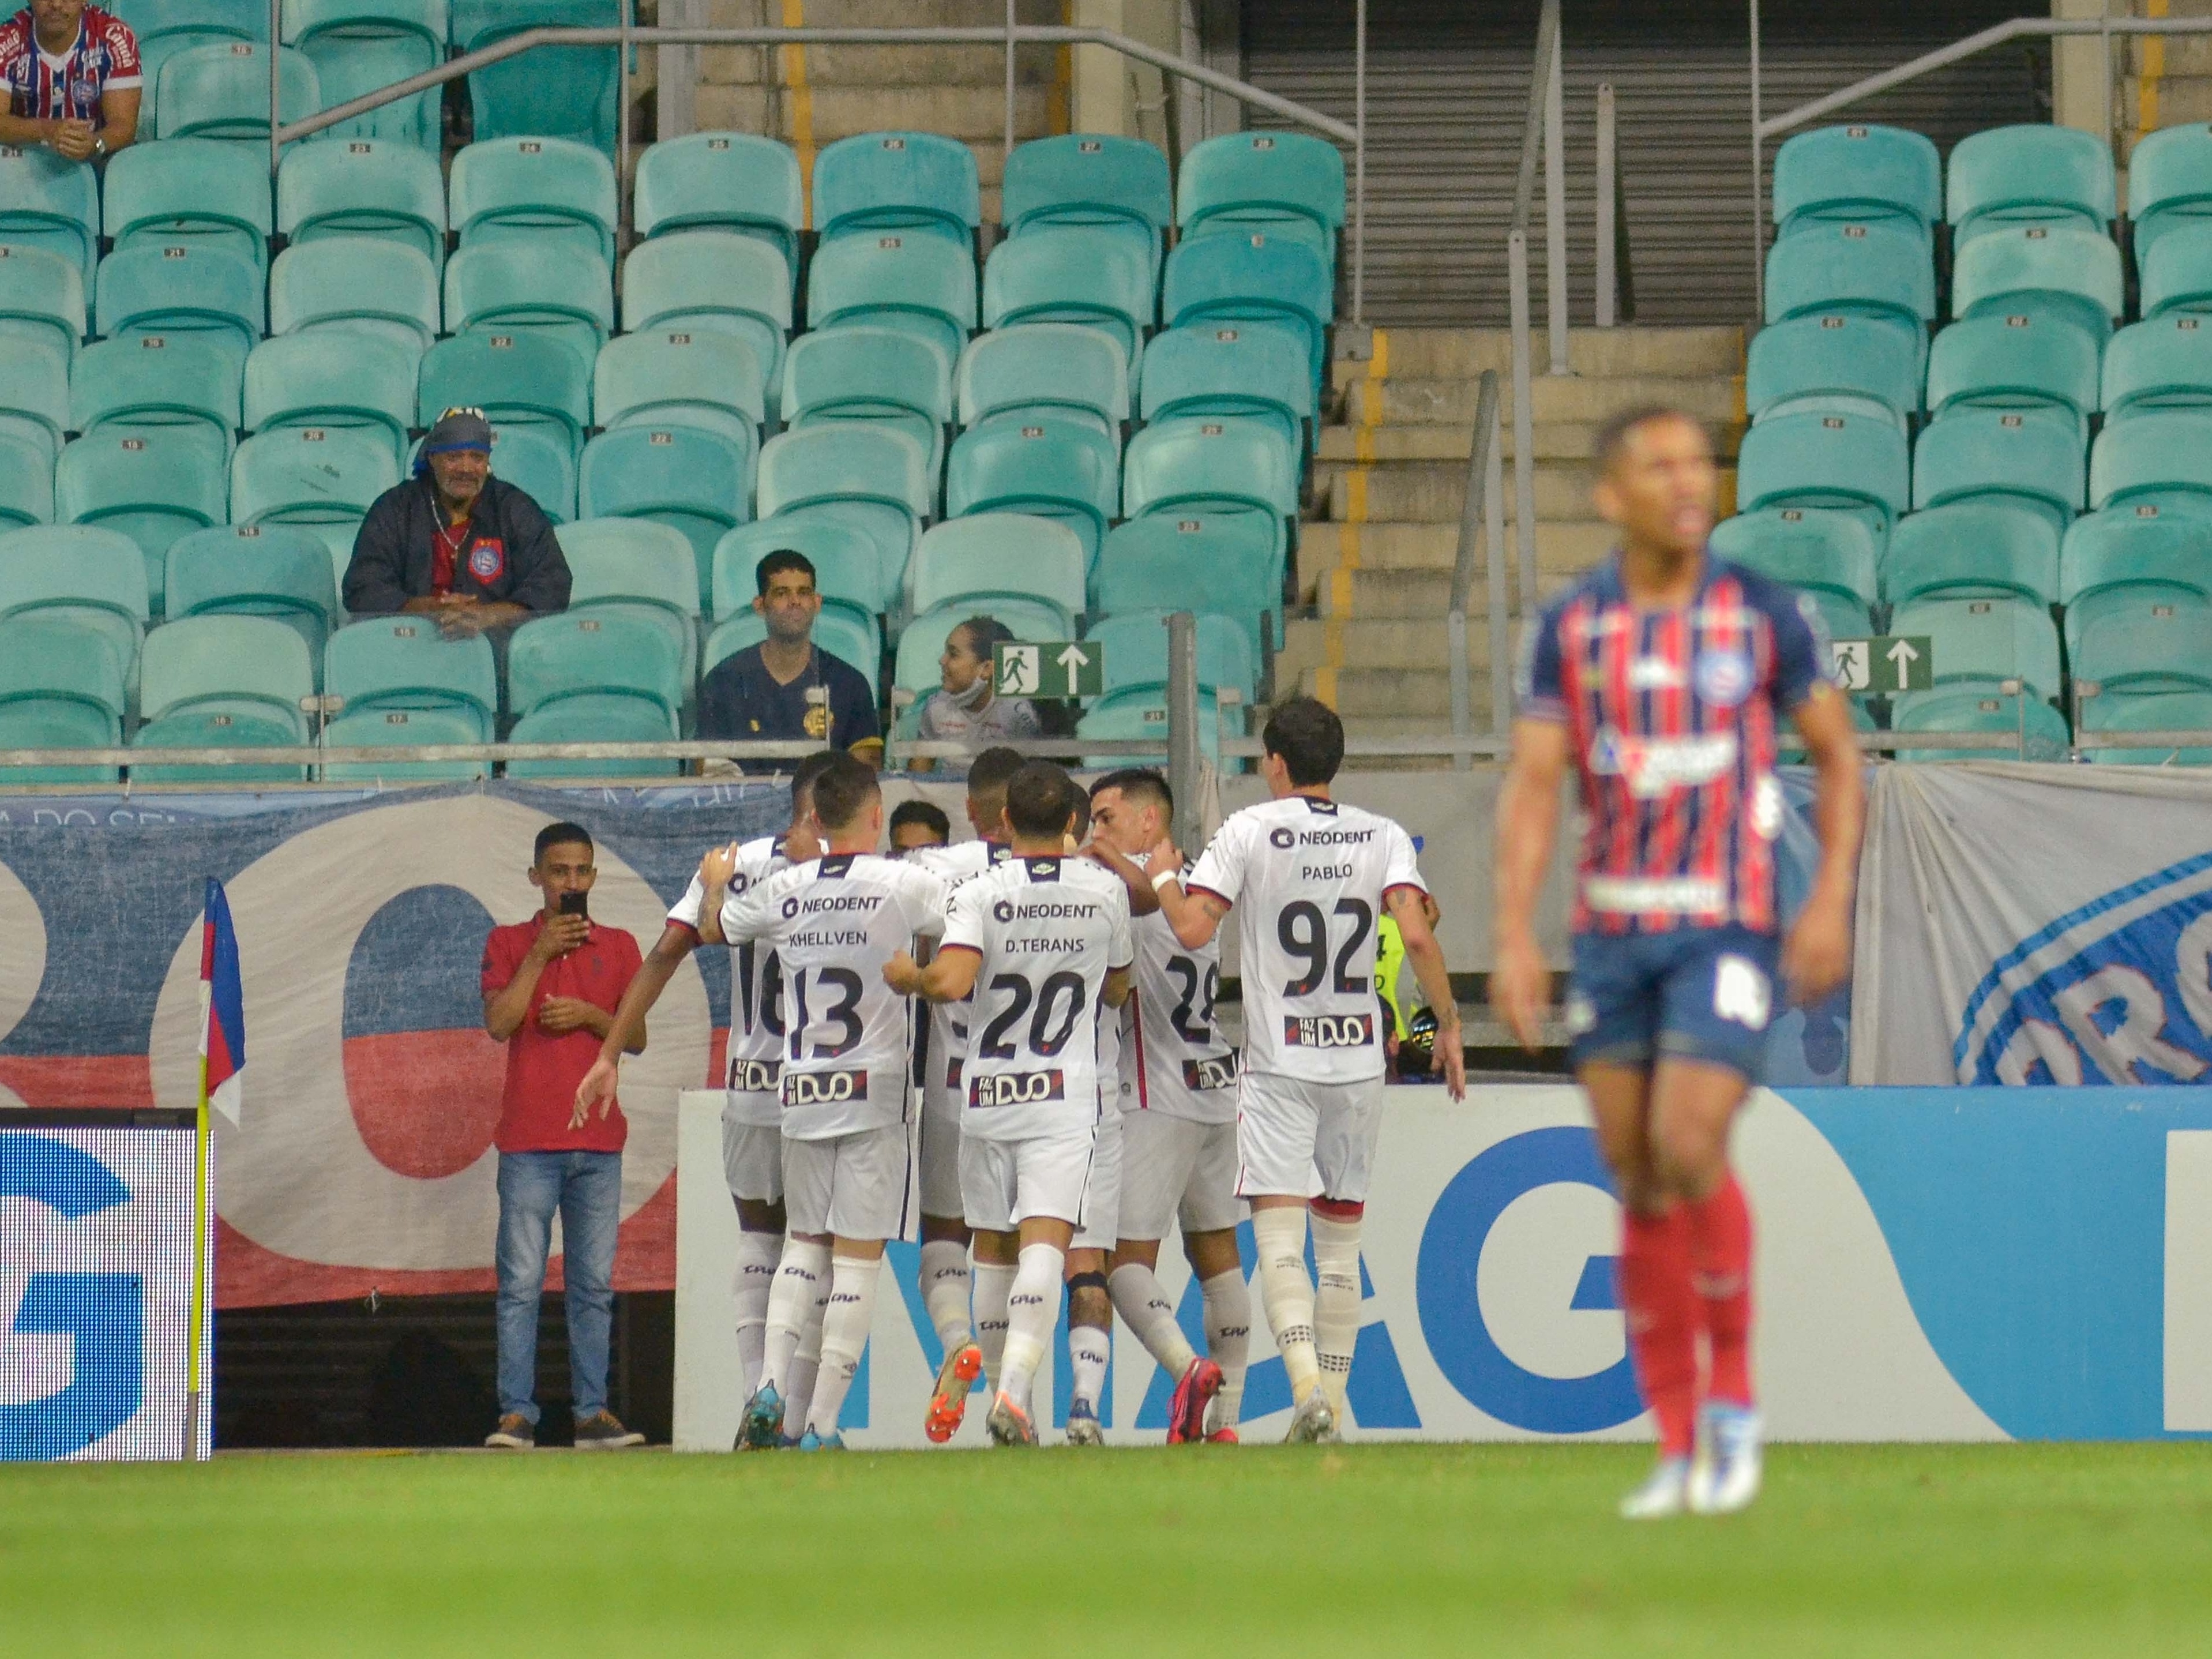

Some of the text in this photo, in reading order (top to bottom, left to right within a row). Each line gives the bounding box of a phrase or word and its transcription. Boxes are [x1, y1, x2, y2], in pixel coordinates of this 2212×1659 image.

[1299, 830, 1373, 845] NEODENT
[1302, 864, 1353, 880] PABLO
[802, 897, 881, 914] NEODENT
[1016, 904, 1096, 918] NEODENT
[789, 931, 867, 948] KHELLVEN
[1005, 938, 1084, 953] D.TERANS
[1278, 898, 1372, 997] 92
[790, 967, 863, 1060] 13
[979, 971, 1086, 1060] 20
[1301, 1031, 1316, 1047] UM
[1317, 1016, 1365, 1048] DUO
[797, 1071, 853, 1106] DUO
[996, 1072, 1050, 1106] DUO
[978, 1090, 994, 1107] UM
